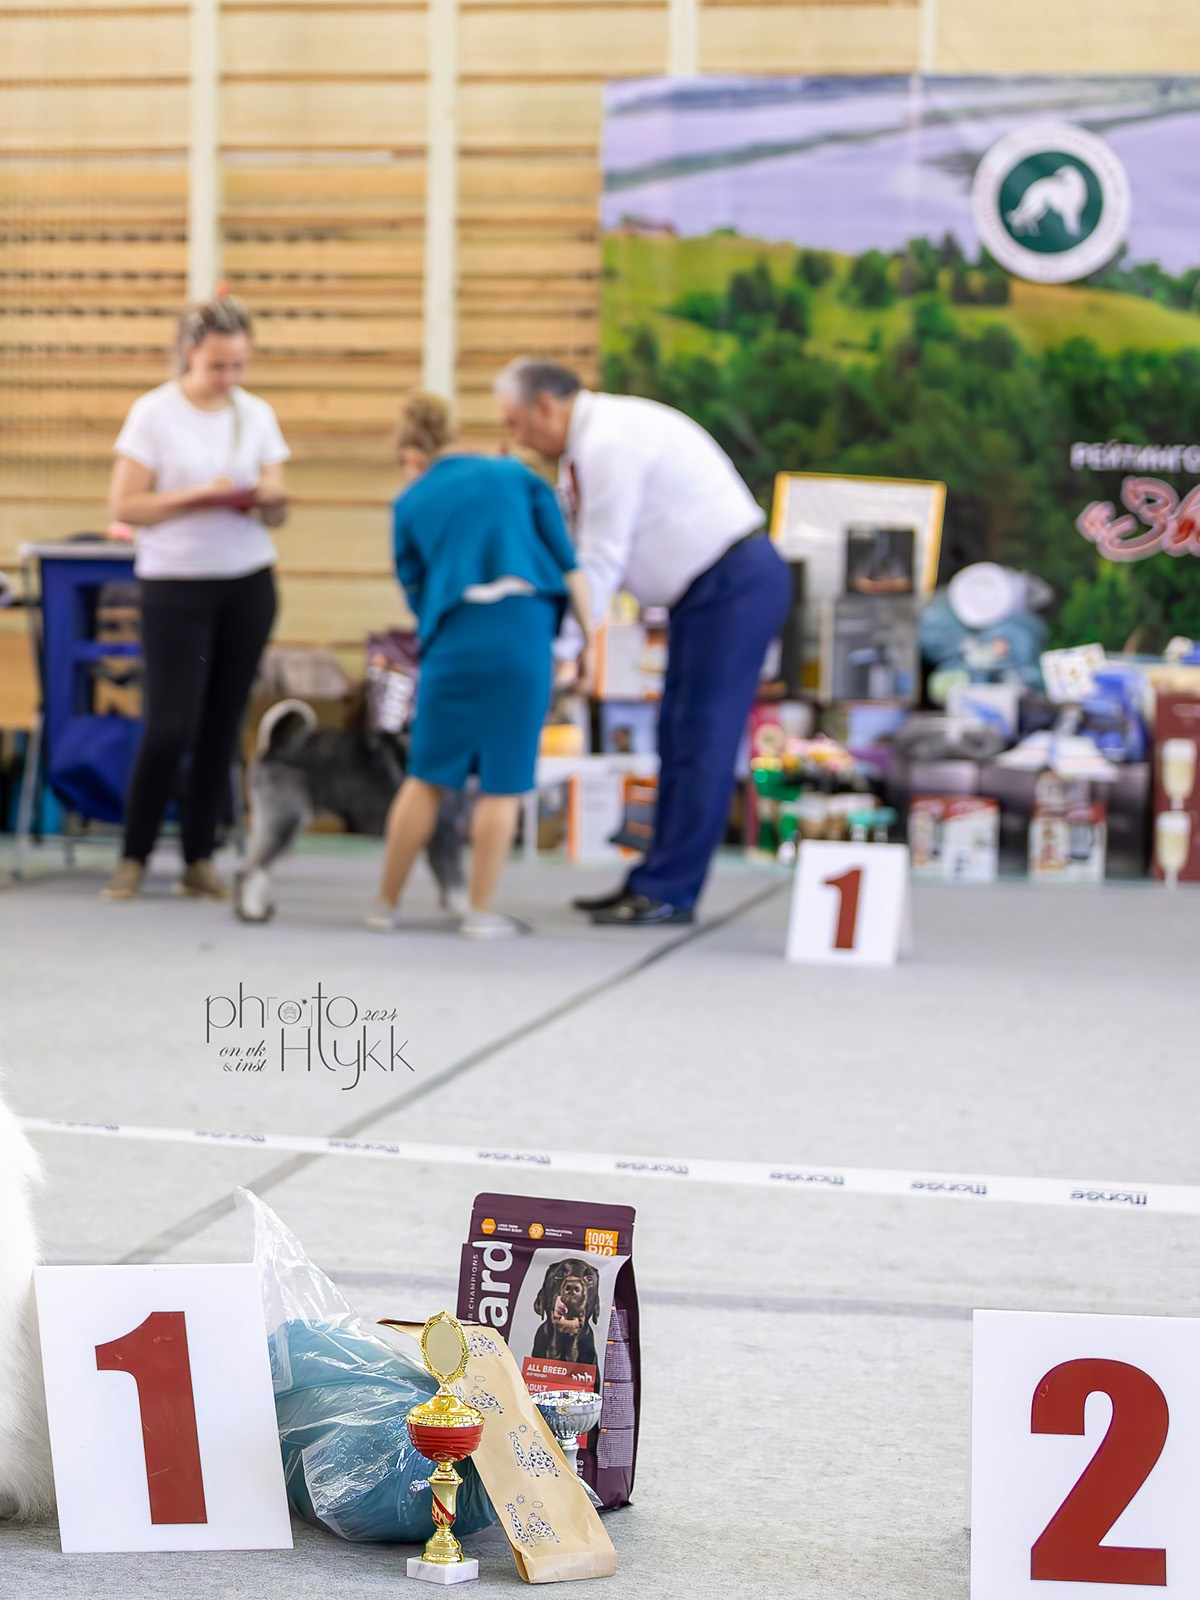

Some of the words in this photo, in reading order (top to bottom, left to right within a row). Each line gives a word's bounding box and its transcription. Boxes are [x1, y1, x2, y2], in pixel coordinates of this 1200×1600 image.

[823, 868, 862, 950] 1
[587, 1231, 614, 1247] 100%
[468, 1254, 478, 1310] CHAMPIONS
[471, 1240, 513, 1328] ard
[526, 1363, 541, 1373] ALL
[542, 1364, 568, 1377] BREED
[95, 1311, 208, 1525] 1
[1030, 1357, 1170, 1587] 2
